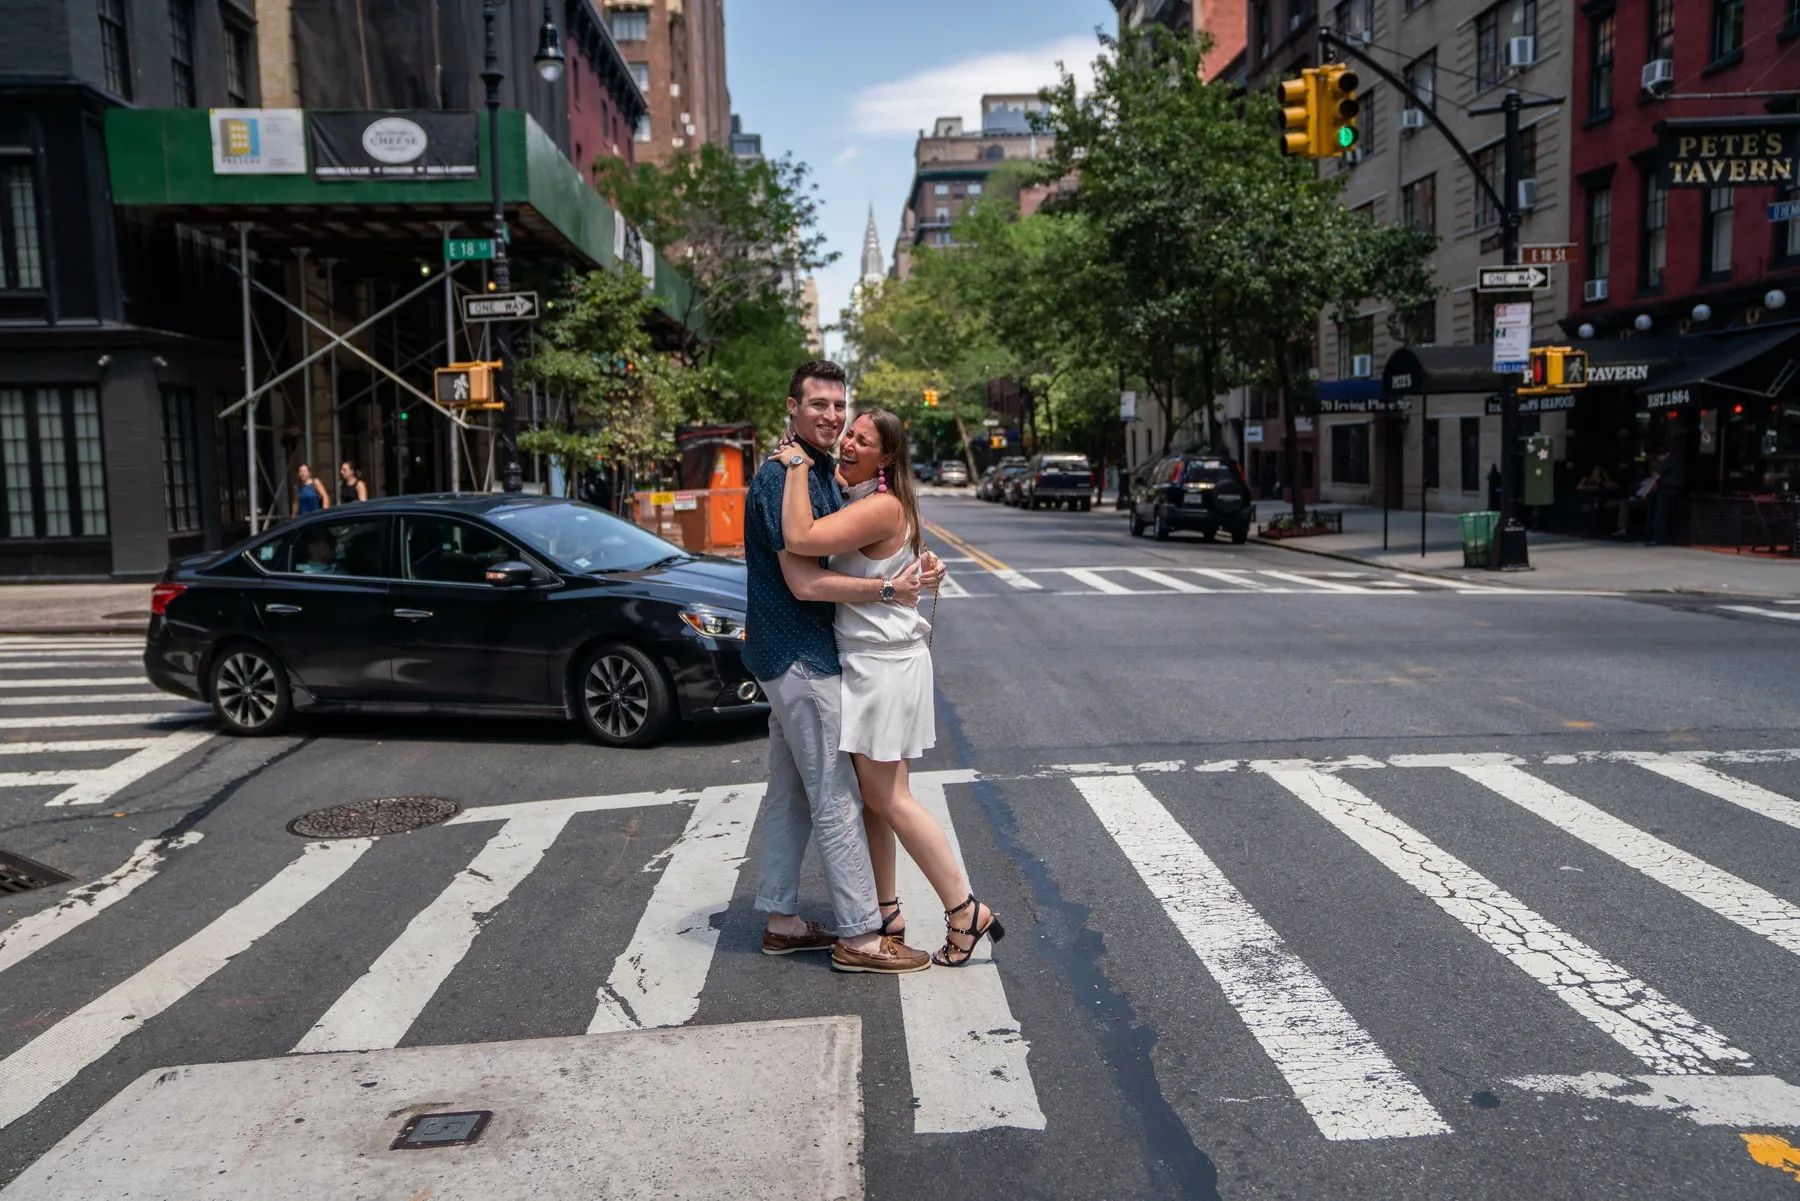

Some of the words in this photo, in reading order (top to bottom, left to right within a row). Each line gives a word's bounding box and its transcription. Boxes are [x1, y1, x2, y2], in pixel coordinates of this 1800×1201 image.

[370, 136, 418, 146] CHEESE
[1678, 129, 1783, 158] PETE'S
[1668, 158, 1793, 184] TAVERN
[449, 242, 456, 257] E
[461, 242, 475, 257] 18
[1531, 249, 1538, 262] E
[1541, 248, 1553, 262] 18
[1488, 273, 1507, 285] ONE
[1518, 271, 1538, 283] WAY
[475, 303, 496, 314] ONE
[504, 301, 525, 312] WAY
[1586, 365, 1650, 382] TAVERN
[1334, 399, 1366, 412] Irving
